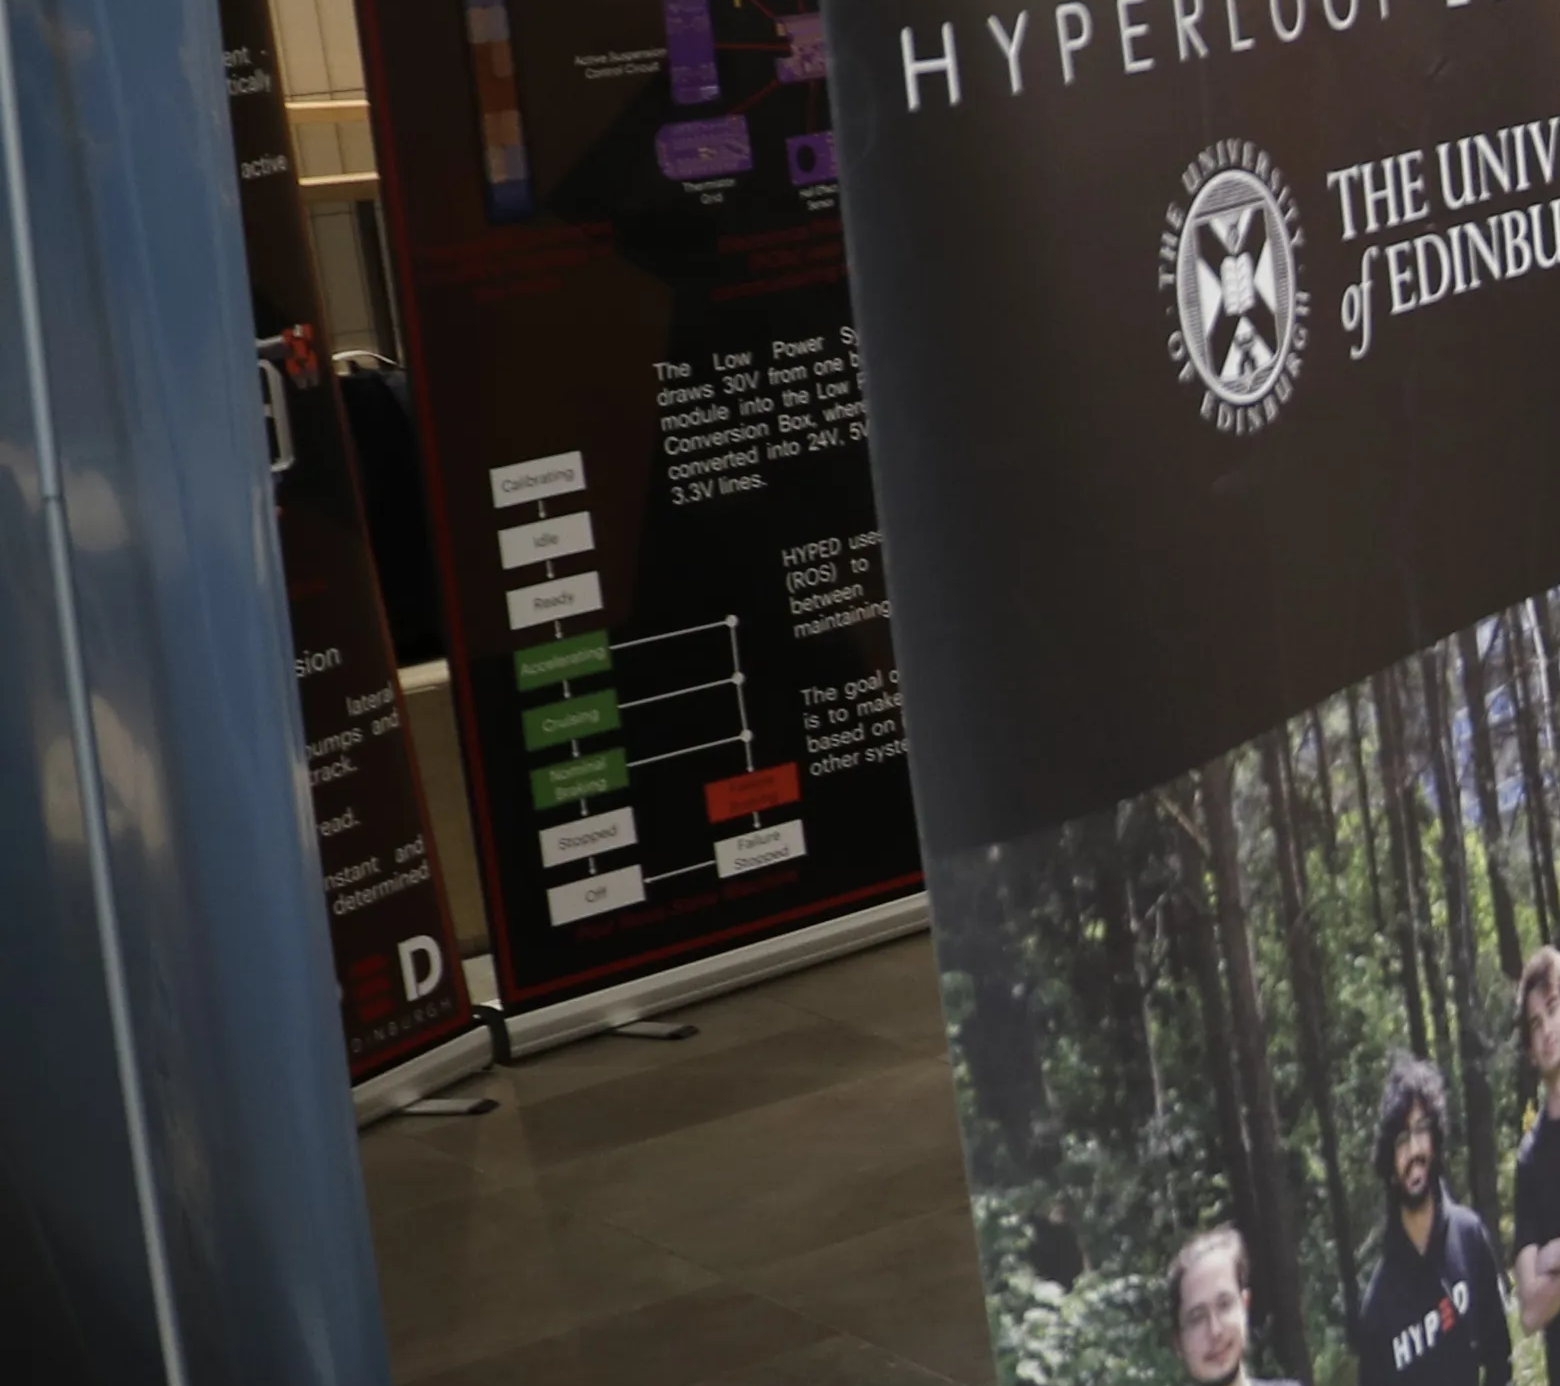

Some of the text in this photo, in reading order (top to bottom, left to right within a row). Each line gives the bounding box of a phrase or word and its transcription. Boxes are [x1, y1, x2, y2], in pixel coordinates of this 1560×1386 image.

[1326, 146, 1428, 242] THE
[1340, 247, 1379, 360] of
[1392, 1279, 1469, 1372] HYPED
